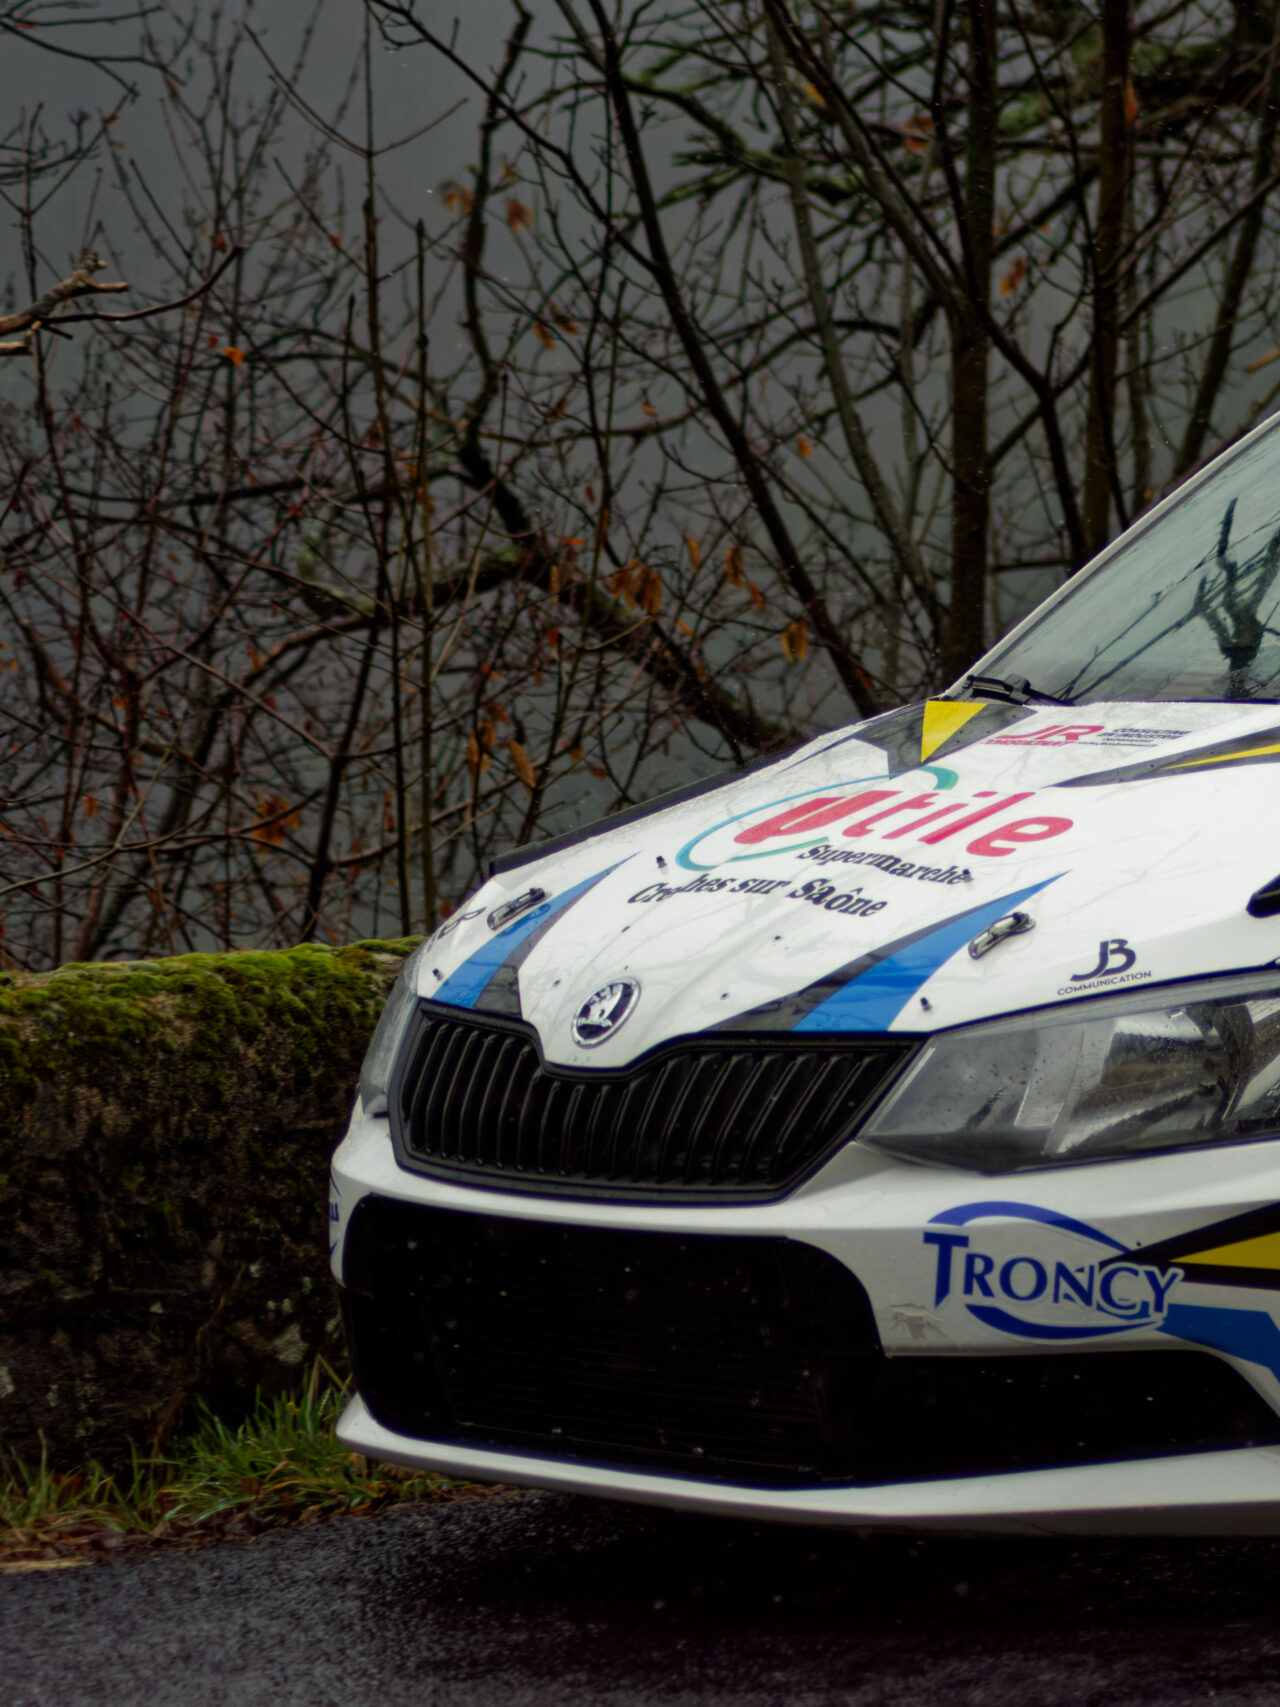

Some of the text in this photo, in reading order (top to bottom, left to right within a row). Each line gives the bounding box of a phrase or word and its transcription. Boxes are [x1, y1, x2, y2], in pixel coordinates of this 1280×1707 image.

[788, 877, 887, 917] Saône
[1057, 970, 1152, 996] COMMUNICATION
[923, 1231, 1180, 1313] TRONCY
